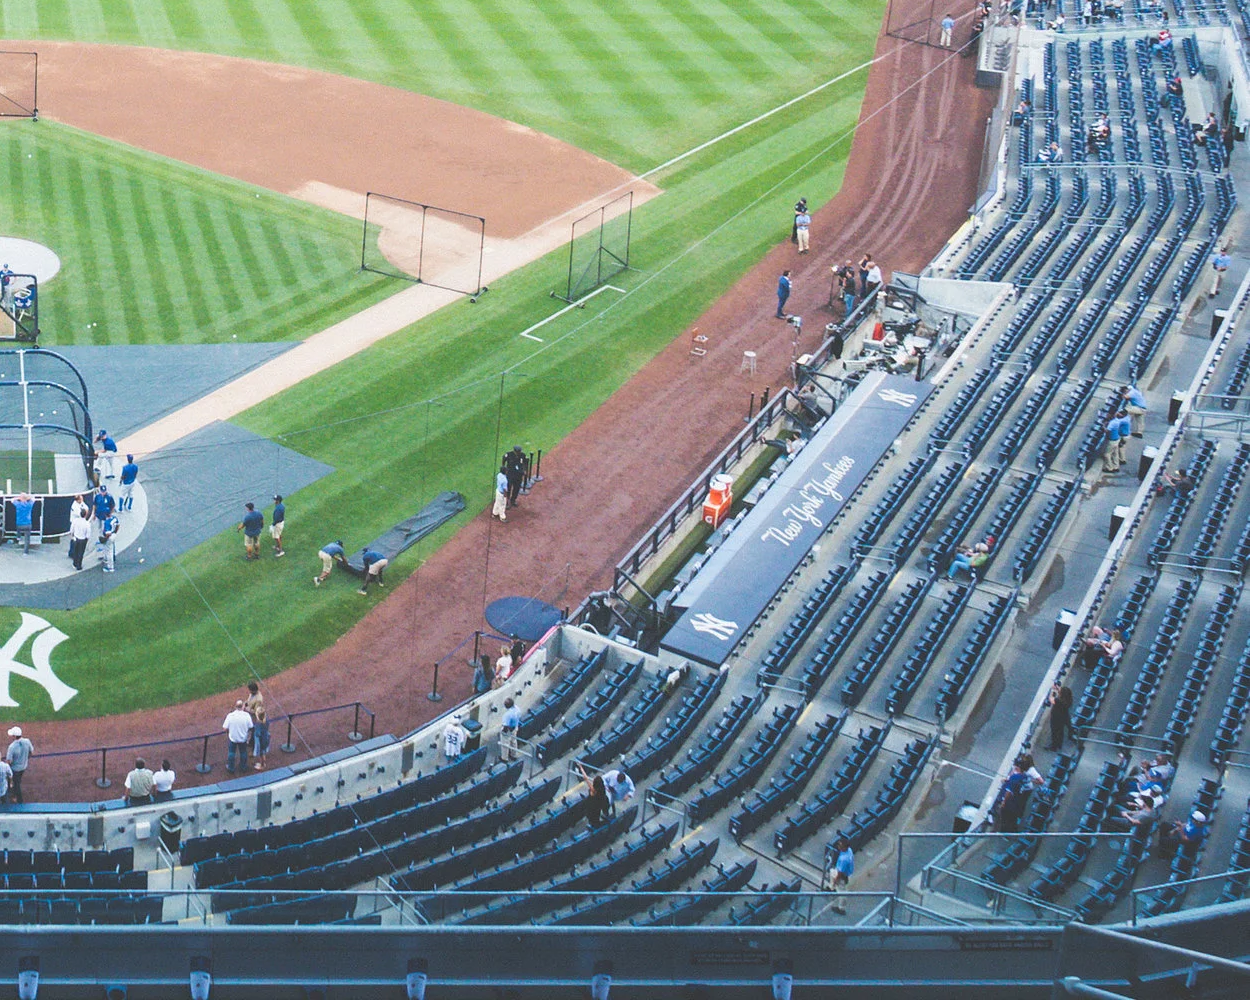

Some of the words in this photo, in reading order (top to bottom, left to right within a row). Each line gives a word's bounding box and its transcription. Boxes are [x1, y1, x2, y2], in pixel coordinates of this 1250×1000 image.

[816, 454, 856, 502] Yankees
[782, 491, 825, 529] York
[761, 518, 804, 547] New
